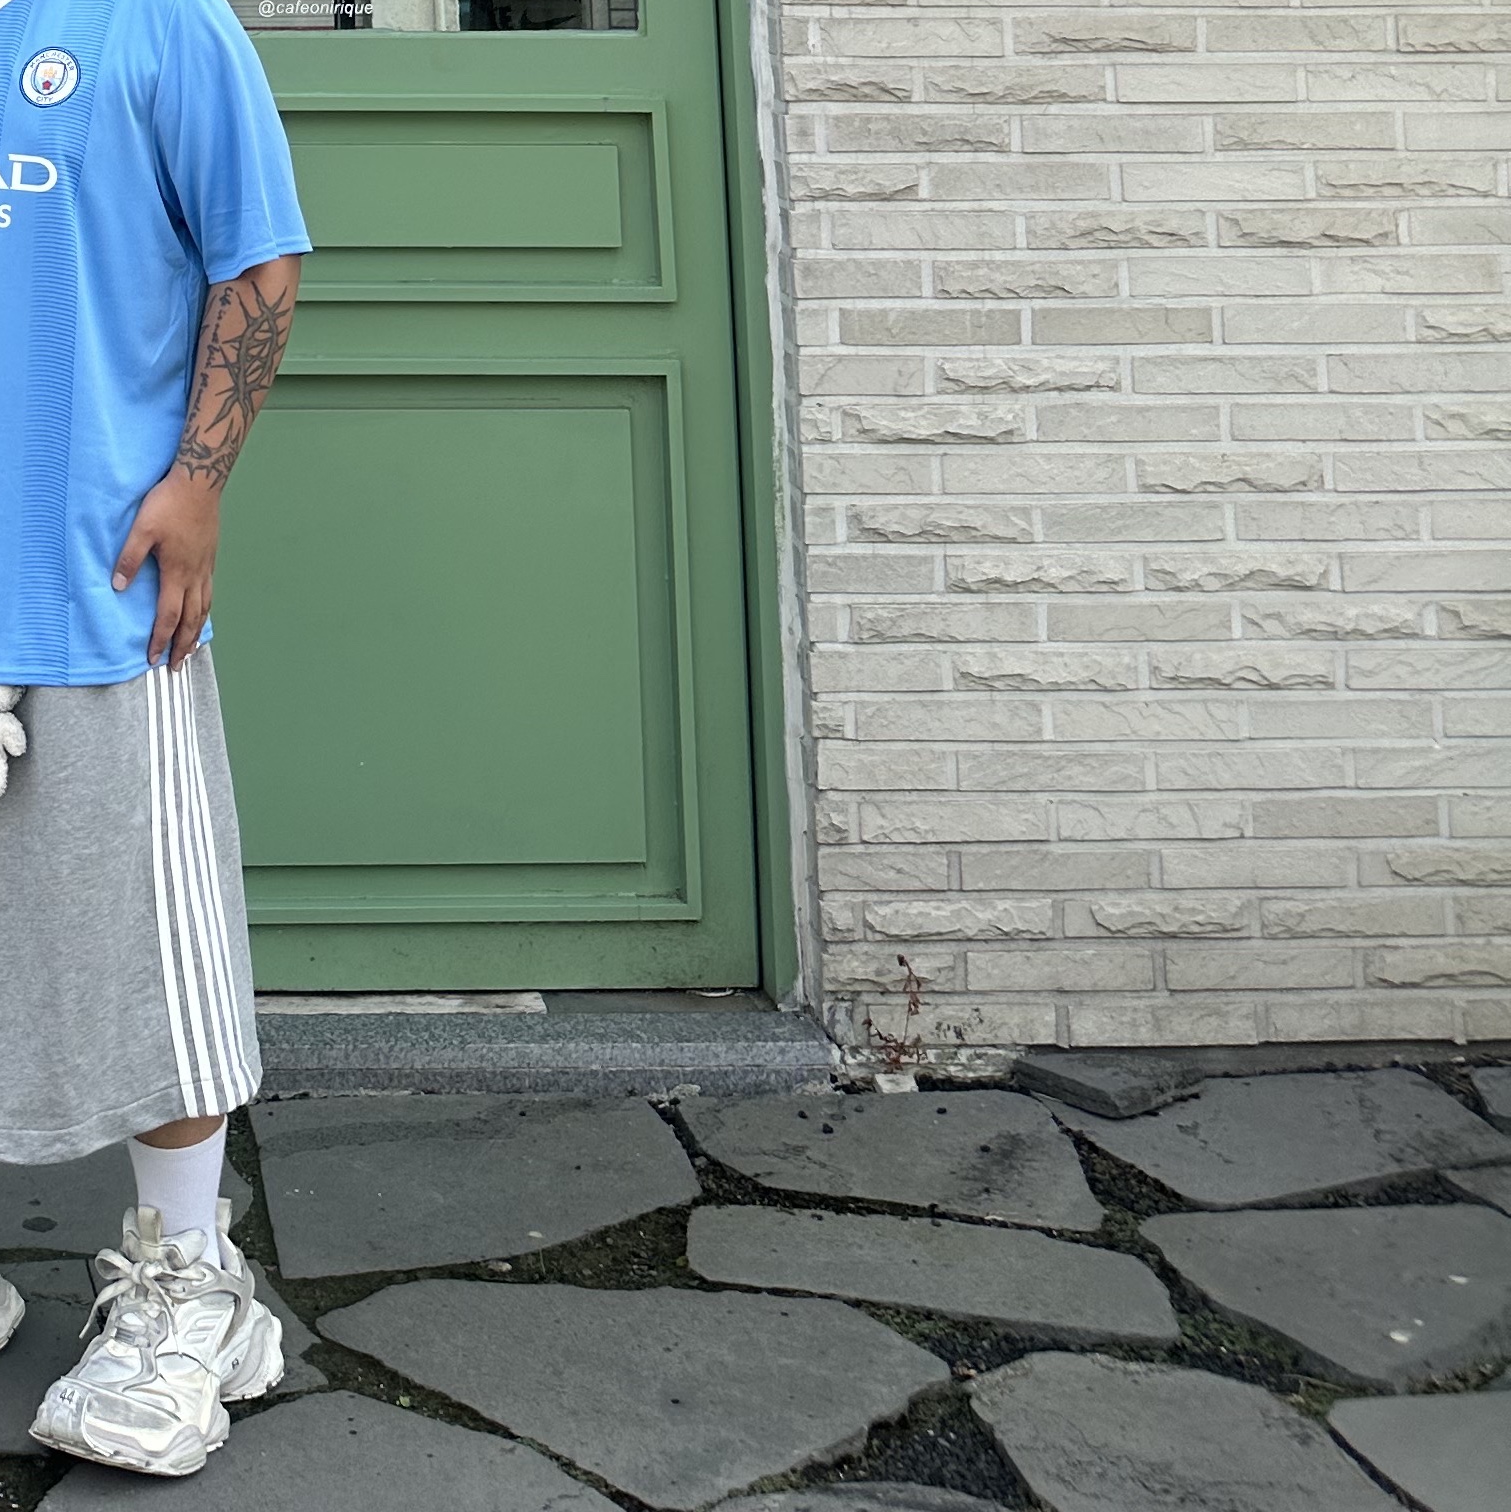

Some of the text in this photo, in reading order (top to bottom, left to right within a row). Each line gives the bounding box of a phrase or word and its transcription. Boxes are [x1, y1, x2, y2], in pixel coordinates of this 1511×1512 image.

[257, 0, 374, 19] @cafeonirique
[36, 95, 54, 103] CITY
[58, 1387, 77, 1405] 44
